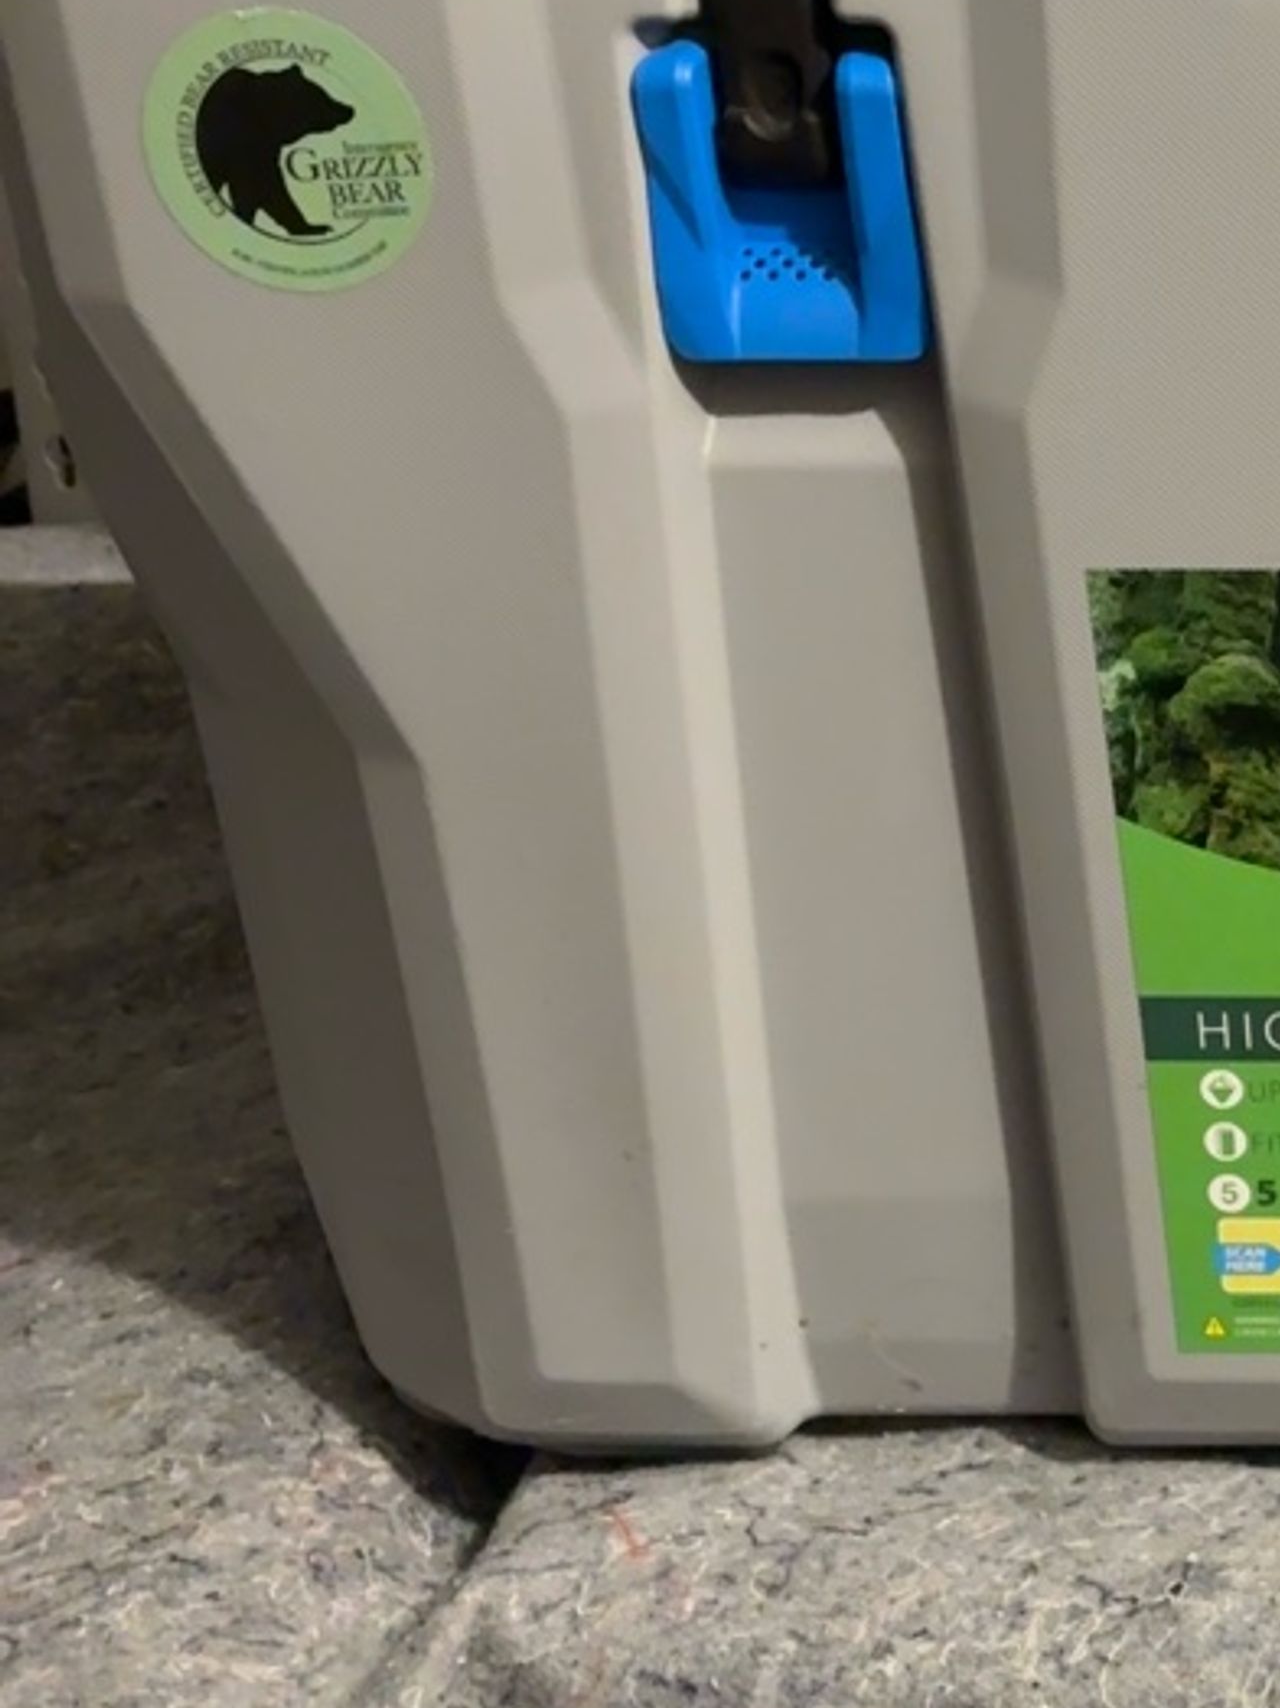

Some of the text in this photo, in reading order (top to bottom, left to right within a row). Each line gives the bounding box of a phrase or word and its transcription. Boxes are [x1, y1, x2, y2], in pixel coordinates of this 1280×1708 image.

[215, 38, 332, 67] RESISTANT
[285, 146, 422, 183] GRIZZLY
[328, 179, 406, 206] BEAR
[1221, 1181, 1239, 1204] 5
